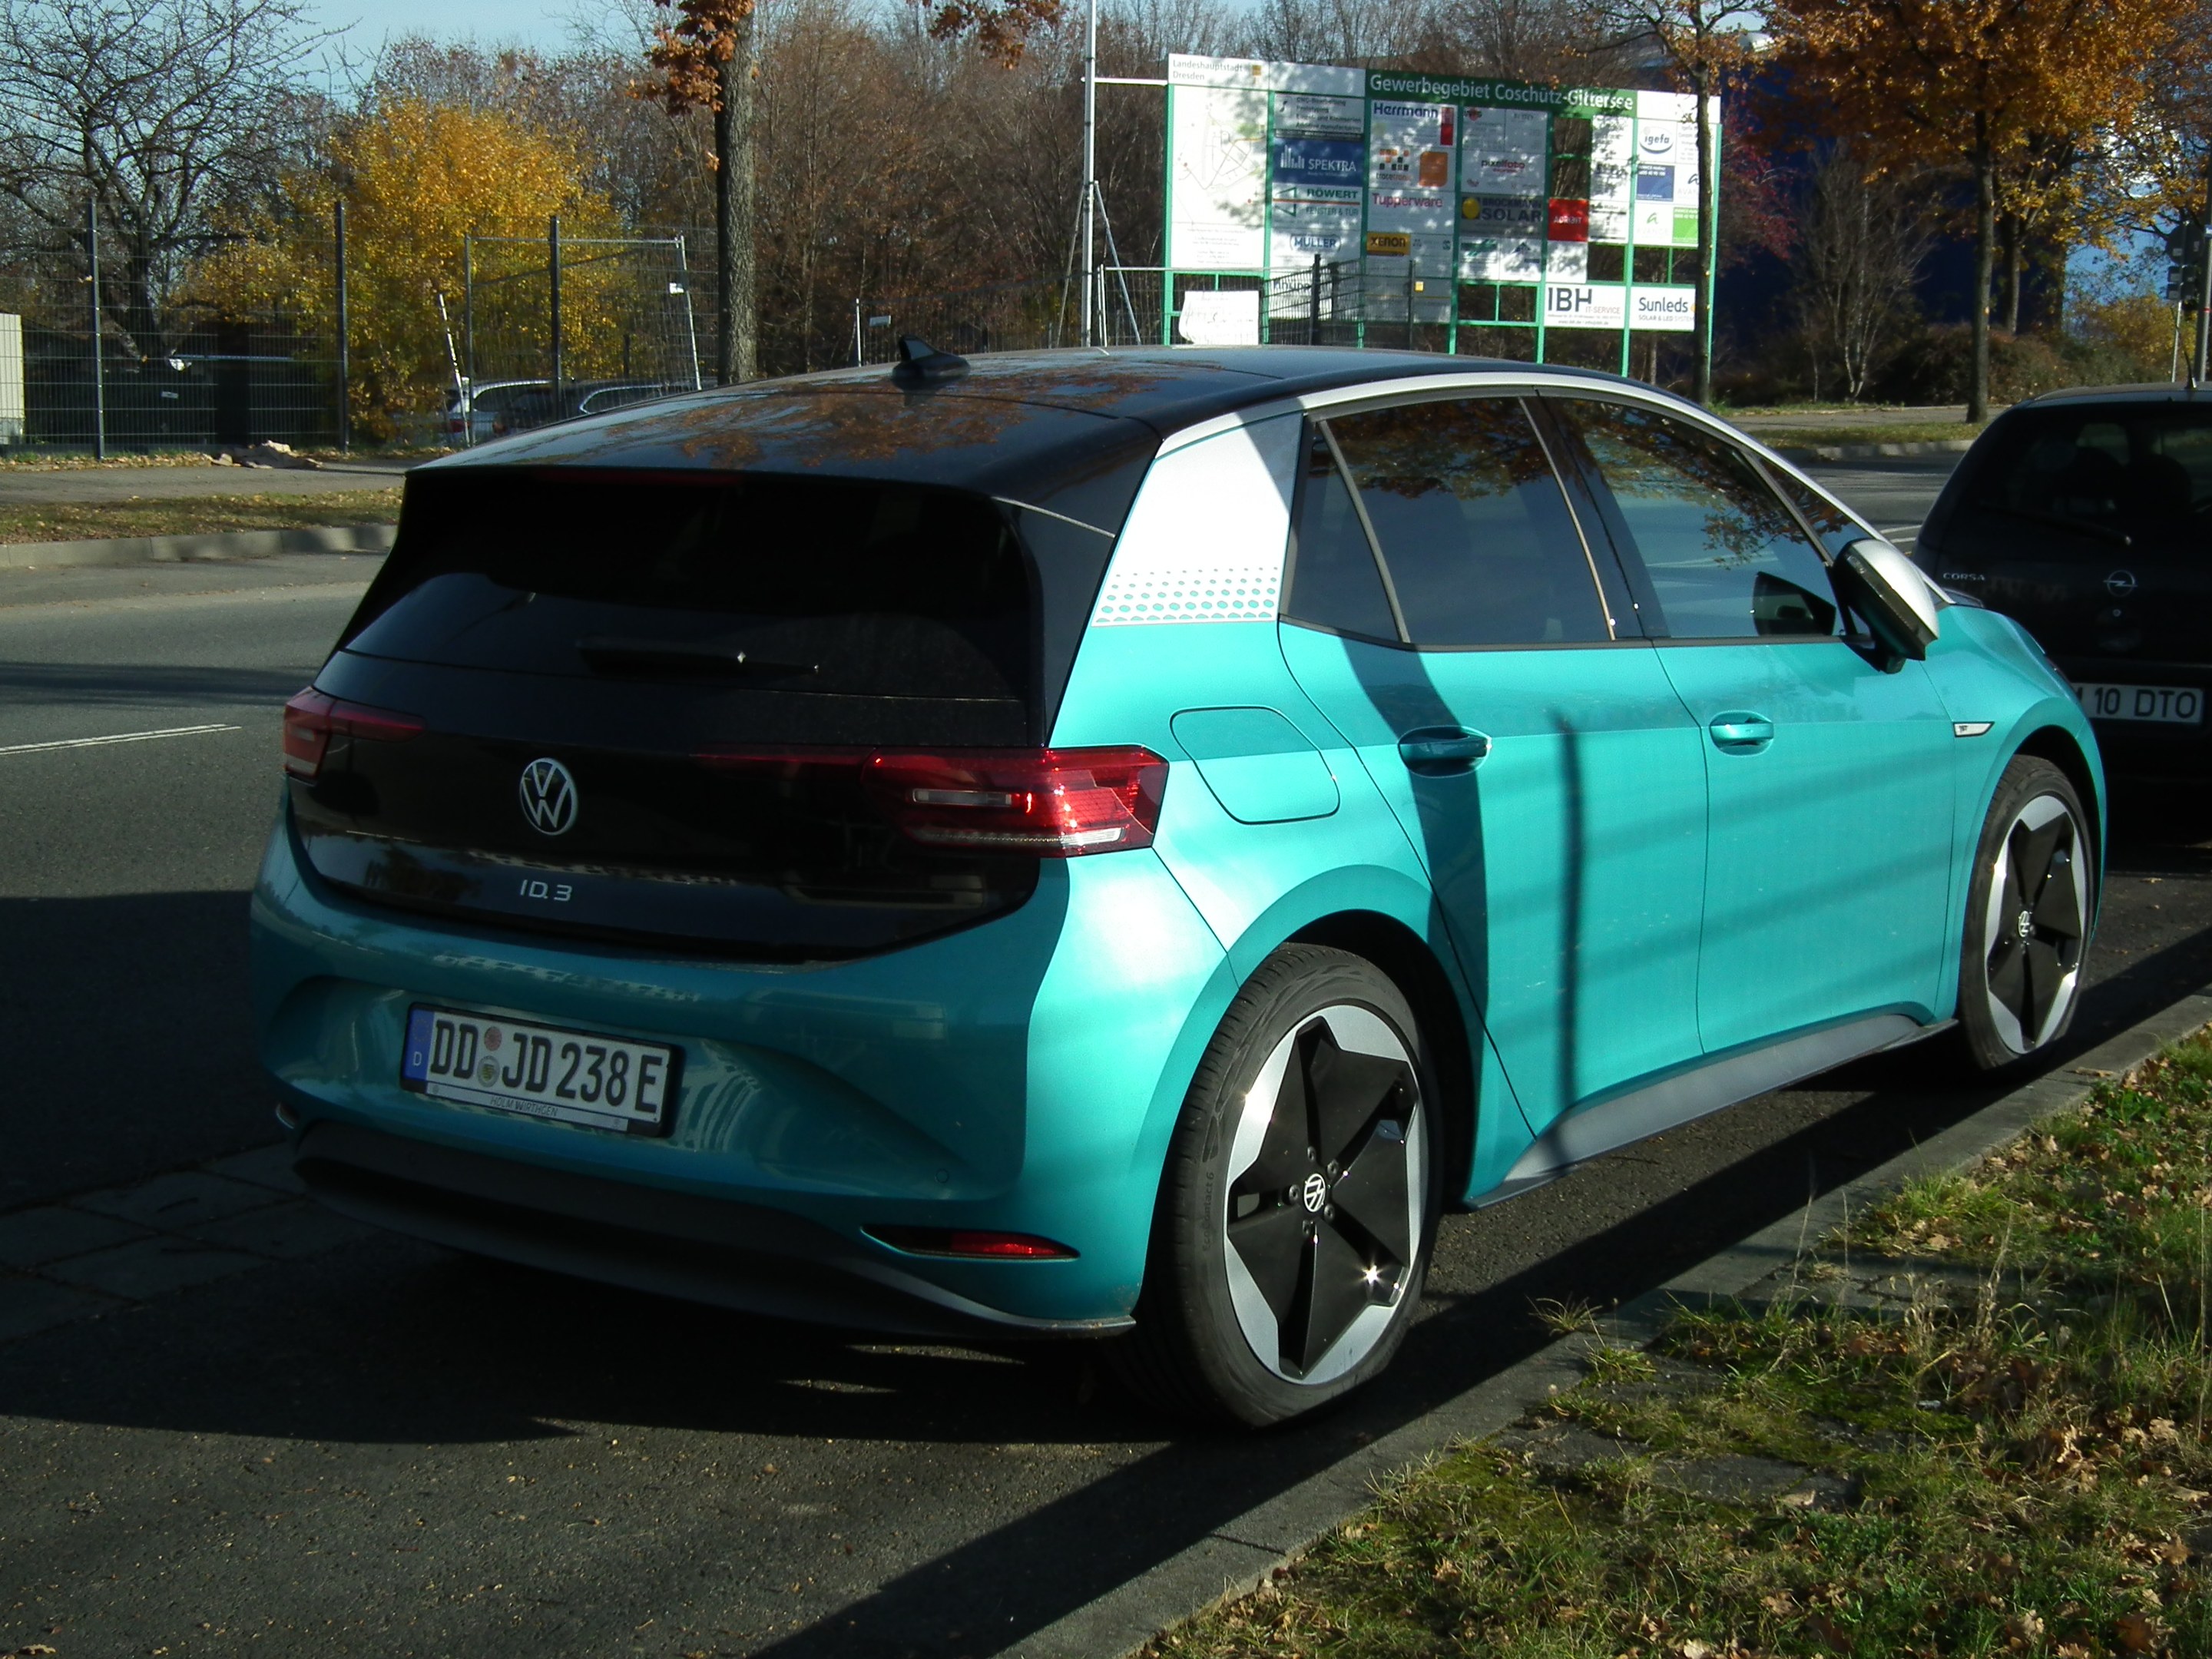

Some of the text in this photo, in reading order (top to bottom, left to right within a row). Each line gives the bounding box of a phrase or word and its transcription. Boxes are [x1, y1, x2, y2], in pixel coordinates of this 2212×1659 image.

[1173, 59, 1243, 72] Landeshauptstadt
[1173, 71, 1205, 80] Dresden
[1370, 74, 1633, 110] Gewerbegebiet Coschütz-Gittersee
[1373, 102, 1439, 118] Herrmann
[1644, 134, 1670, 146] igefa
[1308, 158, 1356, 171] SPEKTRA
[1306, 187, 1358, 199] RÖWERT
[1372, 192, 1443, 207] Tupperware
[1306, 206, 1337, 216] FENSTER
[1481, 207, 1542, 222] SOLAR
[1548, 286, 1593, 313] IBH
[1638, 296, 1688, 313] Sunleds
[1943, 571, 1985, 581] CORSA
[2094, 687, 2121, 715] 10
[2134, 689, 2197, 720] DTO
[430, 1019, 478, 1079] DD
[412, 1051, 422, 1066] D
[515, 1100, 558, 1117] WIRTHGEN
